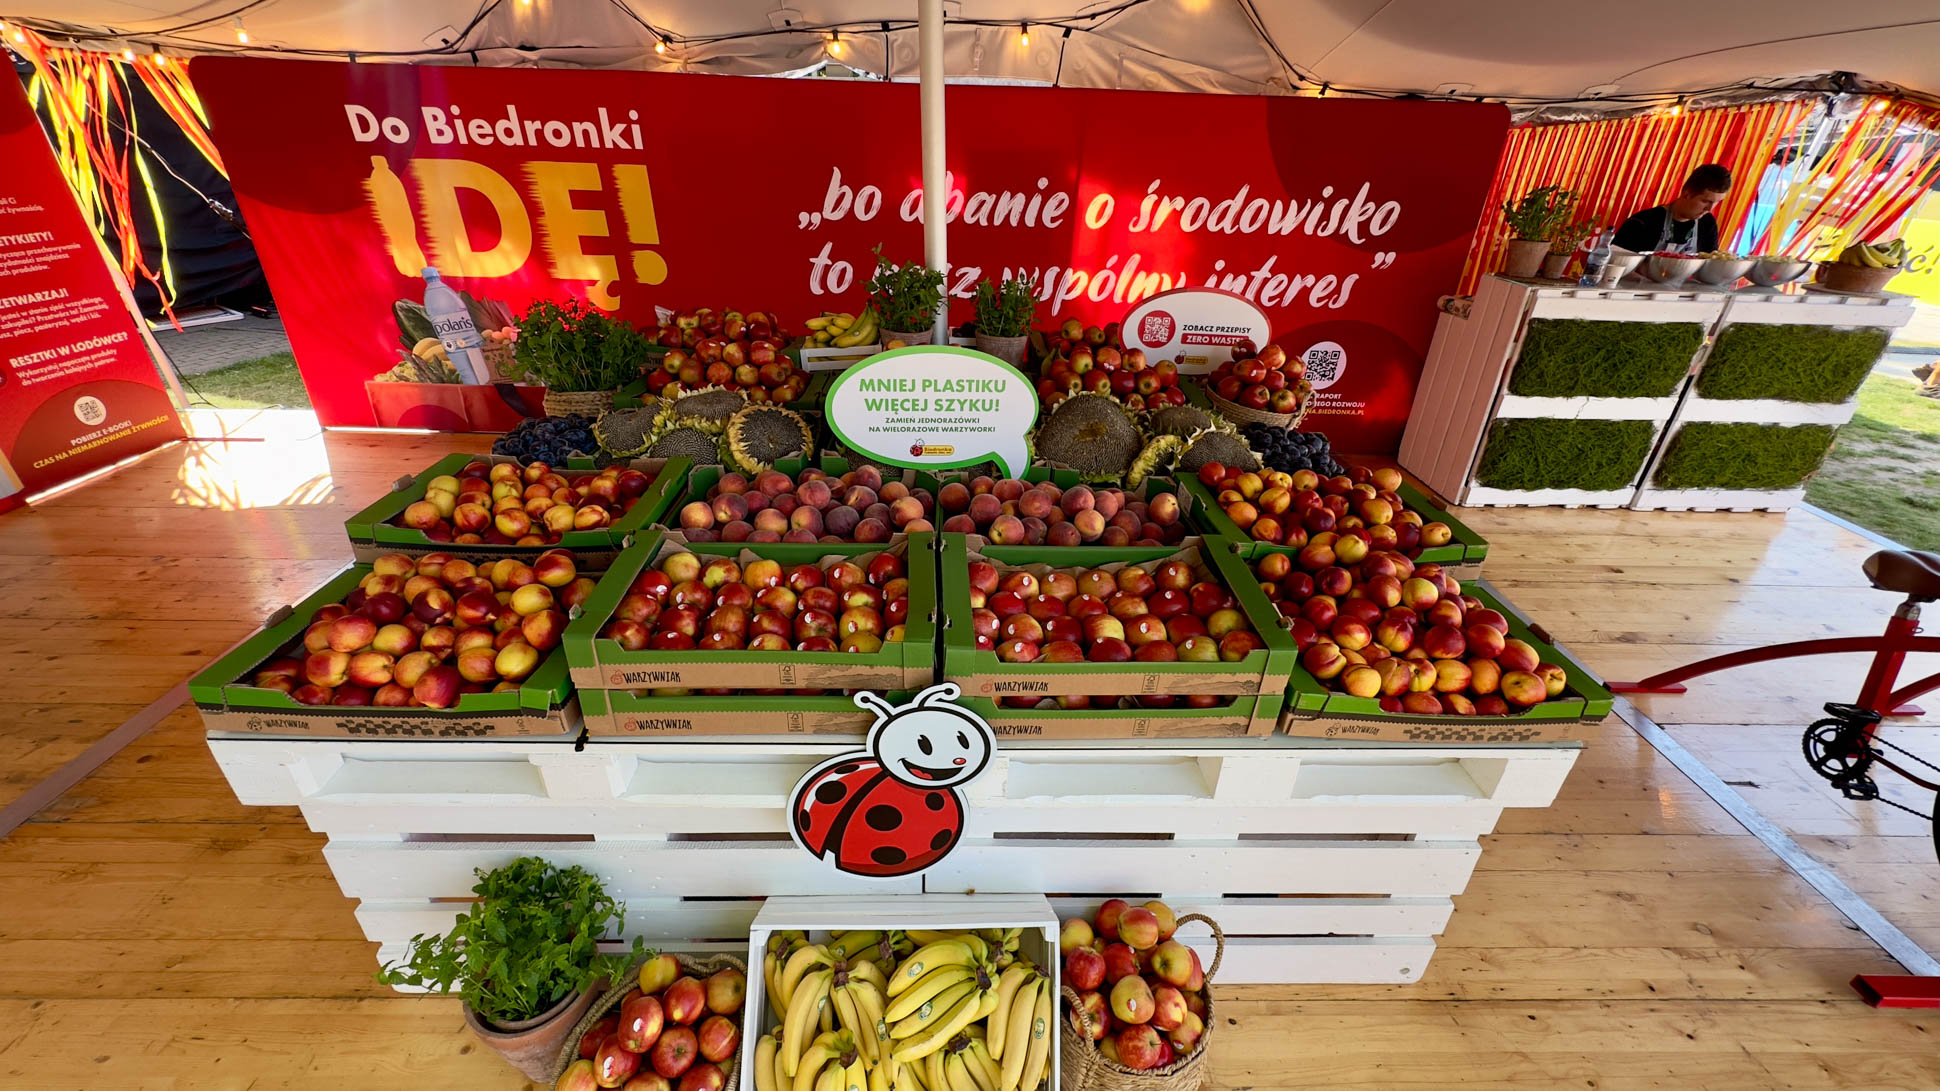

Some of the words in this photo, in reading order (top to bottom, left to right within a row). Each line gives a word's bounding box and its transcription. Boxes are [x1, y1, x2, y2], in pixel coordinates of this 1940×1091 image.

[344, 104, 410, 144] Do
[421, 104, 643, 150] Biedronki
[1085, 193, 1115, 230] o
[1129, 179, 1401, 245] środowisko
[809, 241, 853, 295] to
[433, 317, 474, 337] polaris
[1182, 324, 1214, 333] ZOBACZ
[1215, 326, 1252, 334] PRZEPISY
[1186, 335, 1210, 344] ZERO
[9, 348, 57, 368] RESZTKI
[56, 345, 70, 357] W
[71, 331, 128, 353] LODÓWCE?
[858, 378, 917, 393] MNIEJ
[921, 378, 1007, 393] PLASTIKU
[864, 398, 929, 415] WIĘCEJ
[934, 398, 1000, 412] SZYKU!
[885, 415, 916, 424] ZAMIEŃ
[917, 415, 980, 424] JEDNORAZÓWKI
[70, 430, 103, 446] POBIERZ
[33, 457, 56, 469] CZAS
[55, 451, 69, 463] NA
[68, 429, 132, 457] NIEMARNOWANIE
[623, 671, 681, 683] WARZYWNIAK
[994, 681, 1048, 692] WARZYWNIAK
[636, 719, 692, 730] WARZYWNIAK
